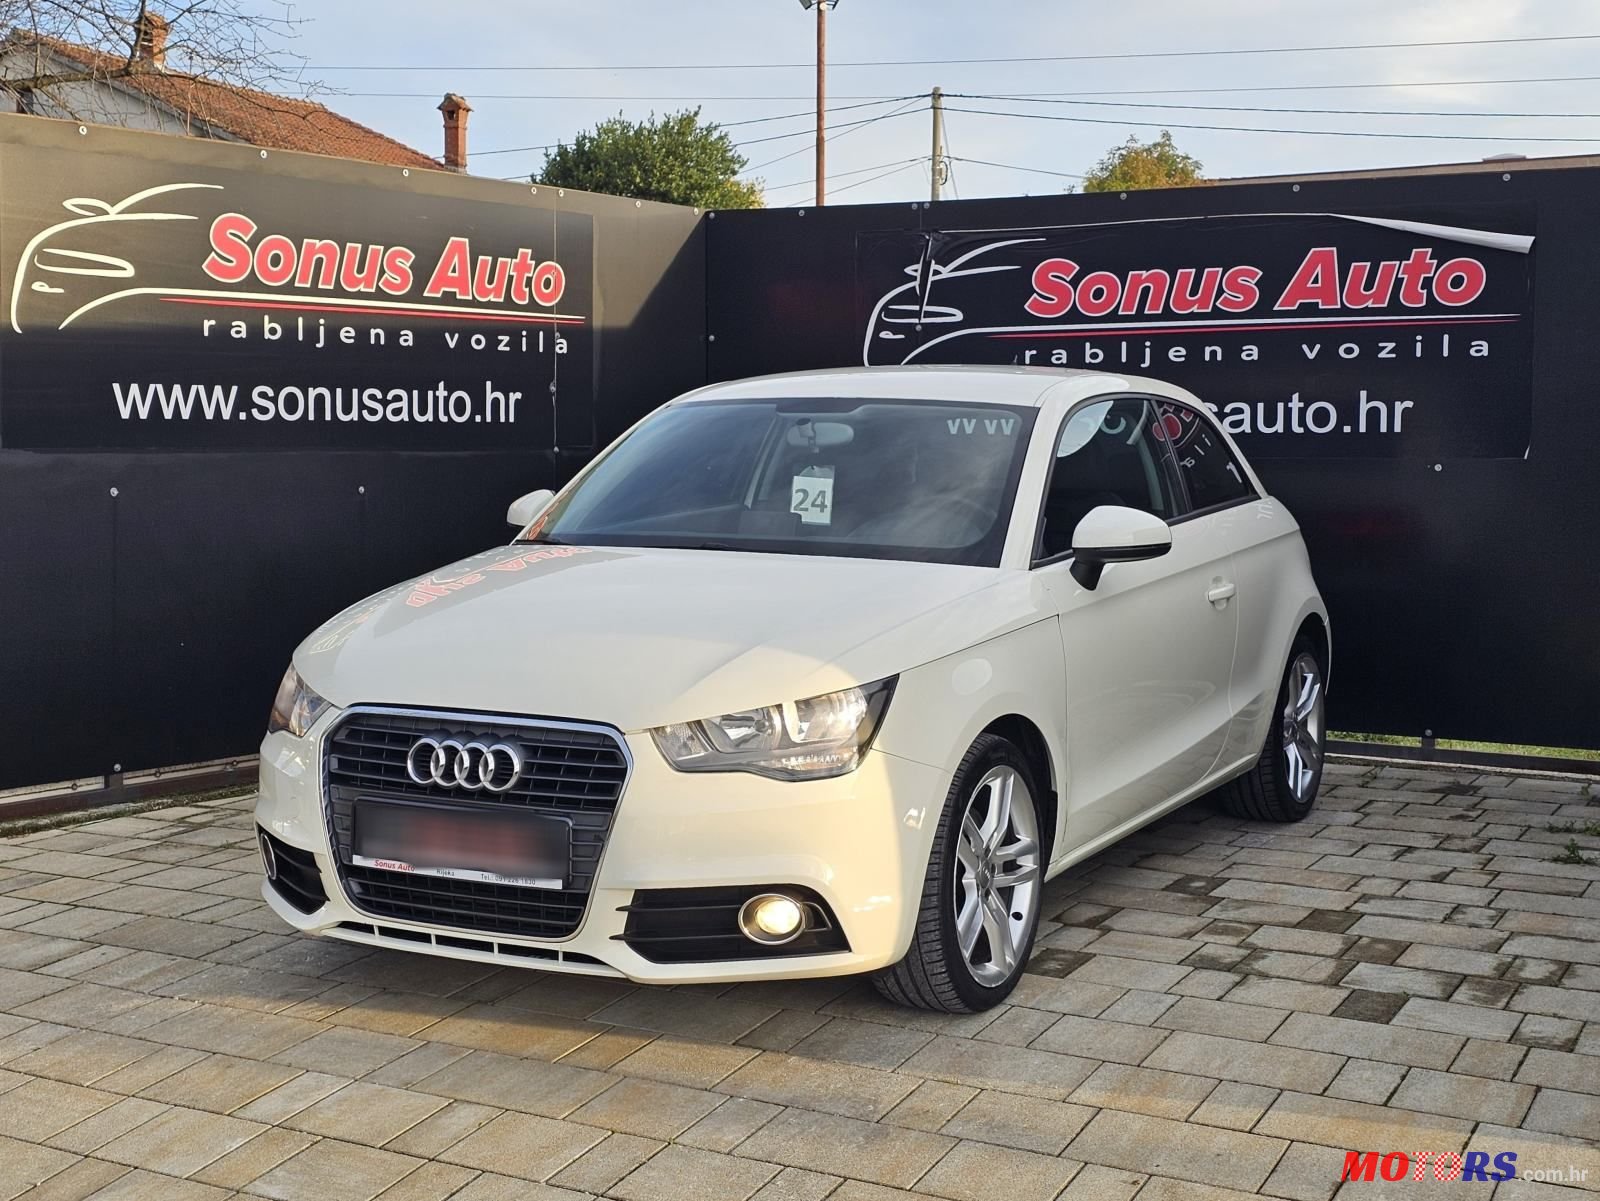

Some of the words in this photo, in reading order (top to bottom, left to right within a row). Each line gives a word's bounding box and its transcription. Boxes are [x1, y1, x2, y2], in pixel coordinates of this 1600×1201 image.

[201, 212, 416, 296] Sonus
[424, 236, 566, 307] Auto
[1024, 257, 1264, 318] Sonus
[1274, 246, 1487, 311] Auto
[203, 315, 414, 349] rabljena
[445, 330, 569, 355] vozila
[1025, 338, 1260, 366] rabljena
[1301, 335, 1490, 360] vozila
[112, 380, 522, 424] www.sonusauto.hr
[792, 488, 828, 513] 24
[374, 859, 396, 869] Sonus
[397, 863, 416, 872] Auto
